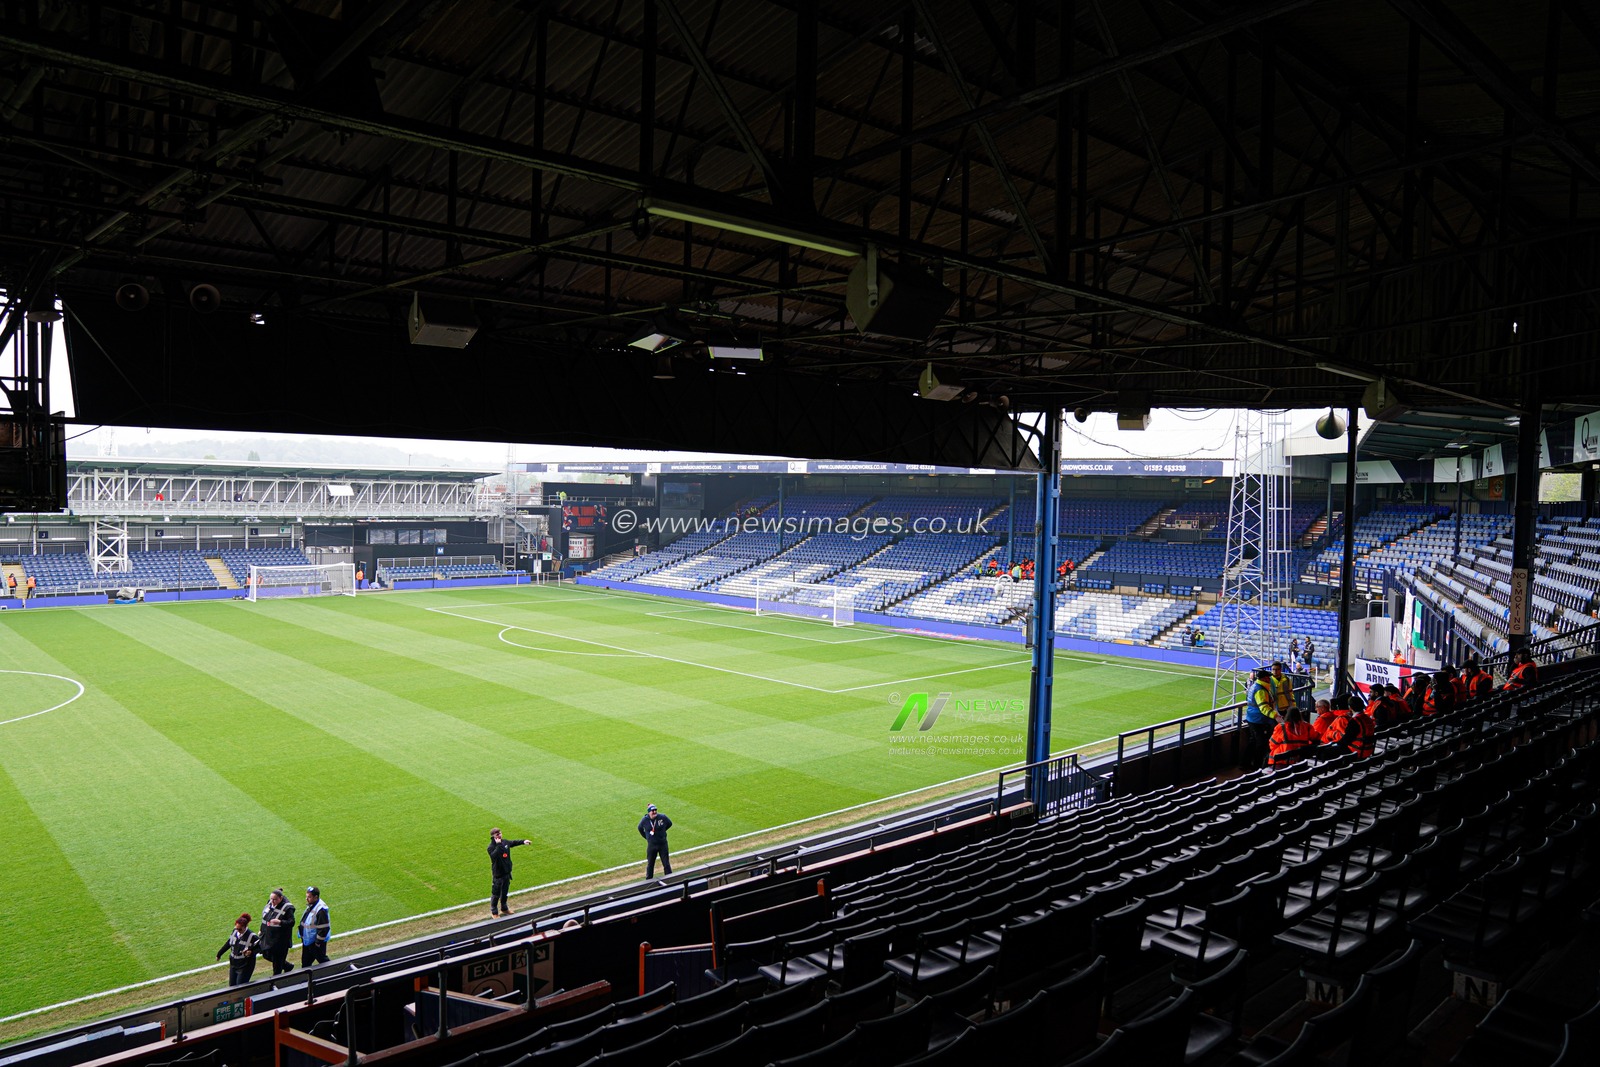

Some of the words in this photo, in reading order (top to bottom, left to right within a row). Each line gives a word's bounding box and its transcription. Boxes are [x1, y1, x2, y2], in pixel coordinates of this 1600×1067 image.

[1512, 572, 1527, 580] NO
[1513, 581, 1523, 631] SMOKING
[1365, 662, 1389, 676] DADS
[473, 959, 504, 979] EXIT
[216, 1005, 232, 1015] FIRE
